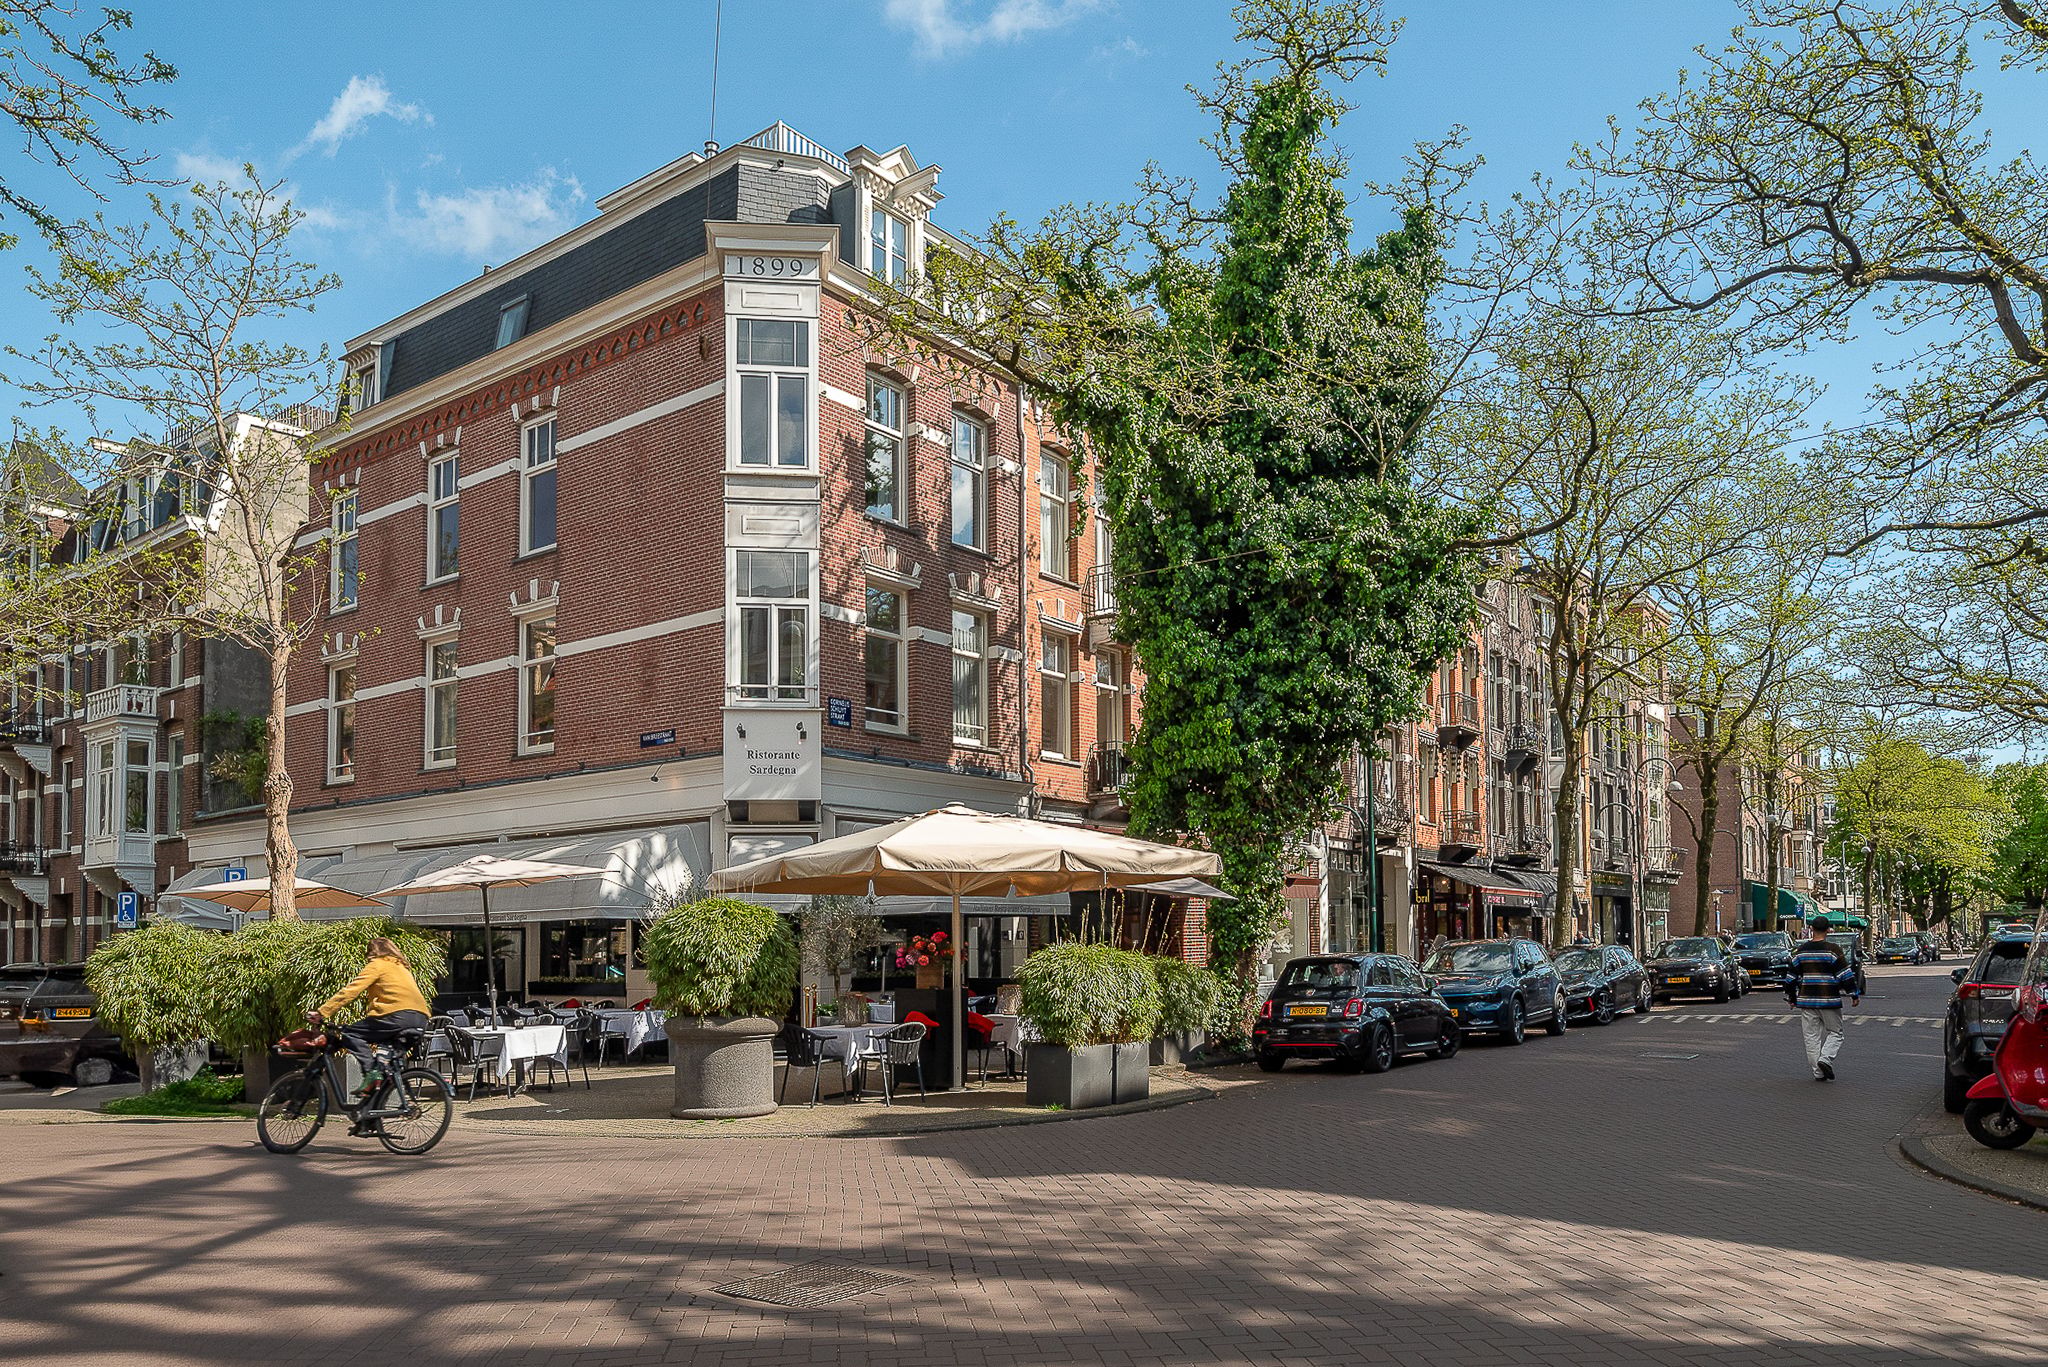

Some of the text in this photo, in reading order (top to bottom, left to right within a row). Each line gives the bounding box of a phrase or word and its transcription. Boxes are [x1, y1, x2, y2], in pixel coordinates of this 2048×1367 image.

[736, 256, 803, 277] 1899
[747, 750, 801, 760] Ristorante
[749, 764, 797, 776] Sardegna
[122, 895, 133, 910] P
